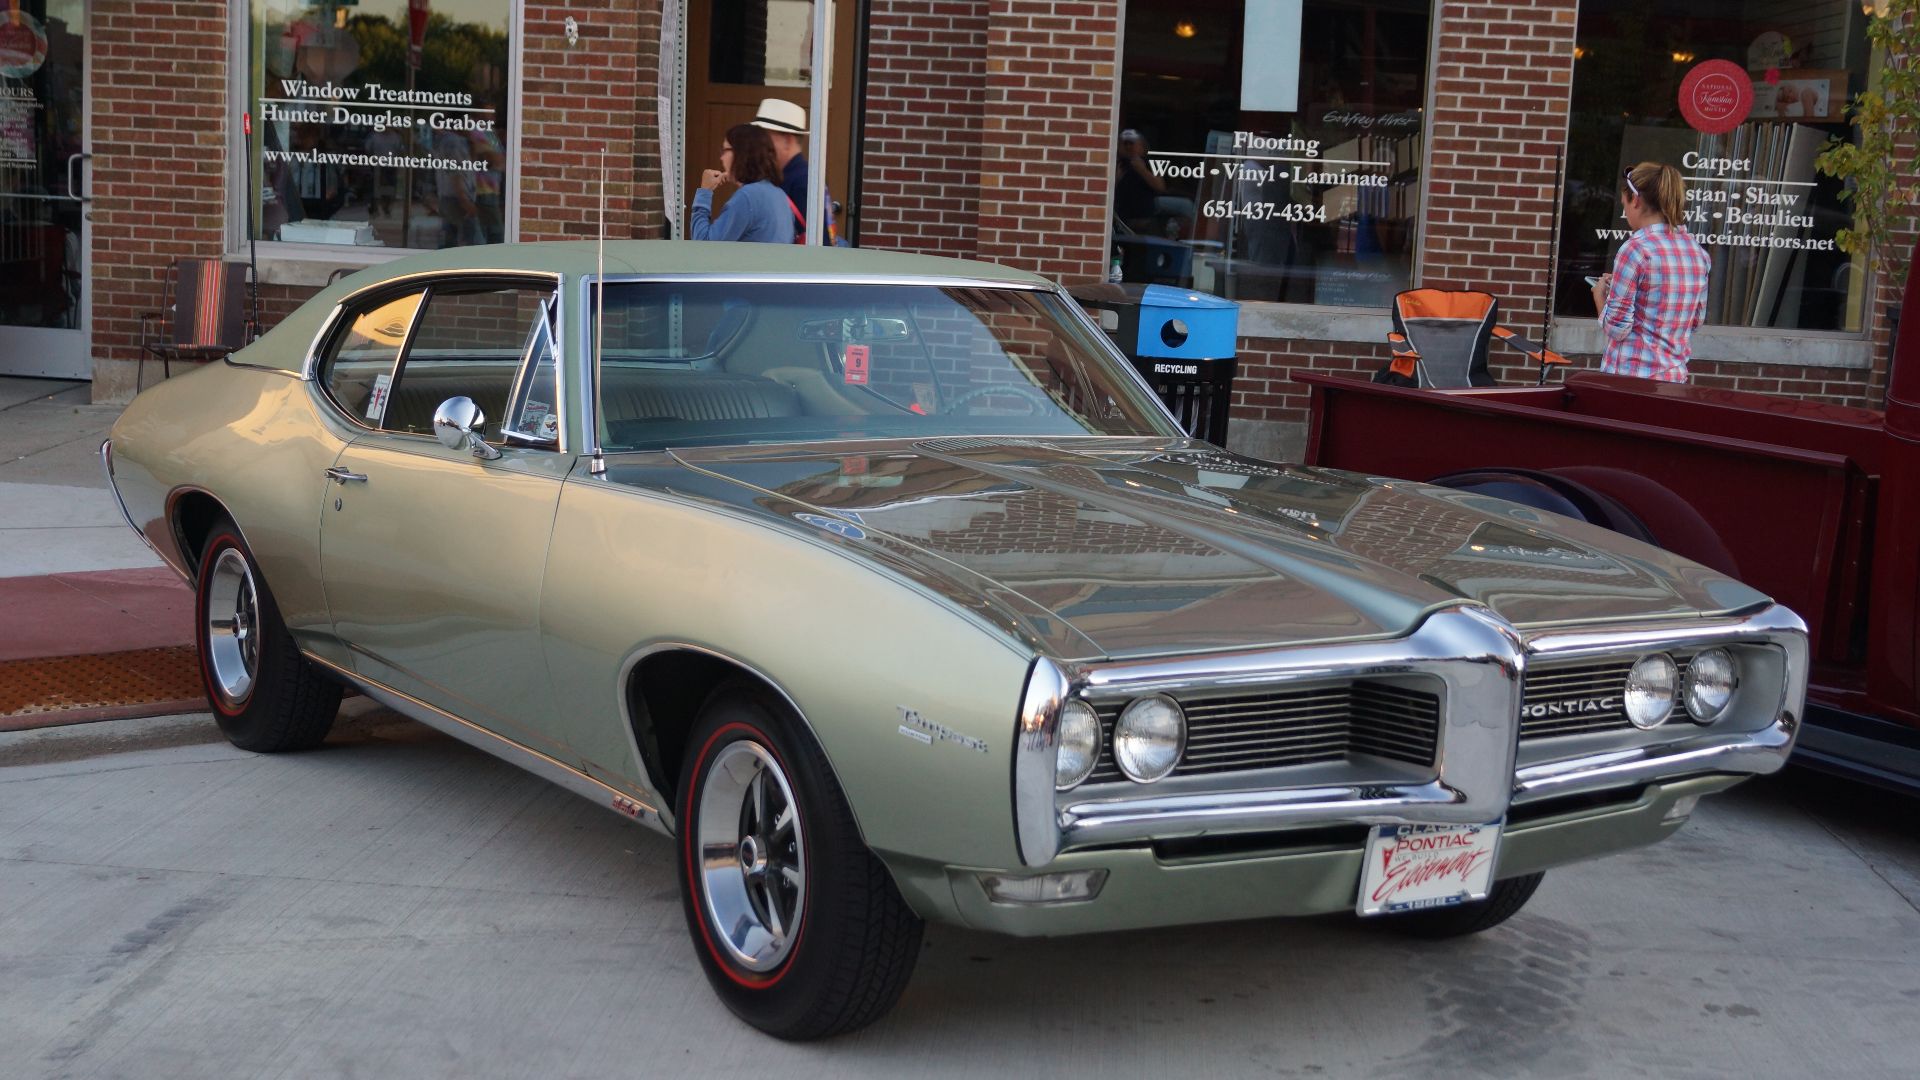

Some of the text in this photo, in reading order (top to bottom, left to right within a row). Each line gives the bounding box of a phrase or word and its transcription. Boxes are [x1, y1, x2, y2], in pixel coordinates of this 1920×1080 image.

[281, 79, 472, 105] Window Treatments
[259, 103, 495, 132] Hunter Douglas Graber
[1233, 131, 1320, 157] Flooring
[264, 147, 489, 172] www.lawrenceinteriors.net
[1682, 151, 1750, 175] Carpet
[1149, 159, 1389, 188] Wood Vinyl Laminate
[1685, 187, 1799, 206] stan Shaw
[1203, 200, 1326, 223] 651-437-4334
[1726, 207, 1815, 228] Beaulieu
[1154, 363, 1198, 375] RECYCLING
[1521, 697, 1614, 717] PONTIAC
[1396, 832, 1475, 852] PONTIAC
